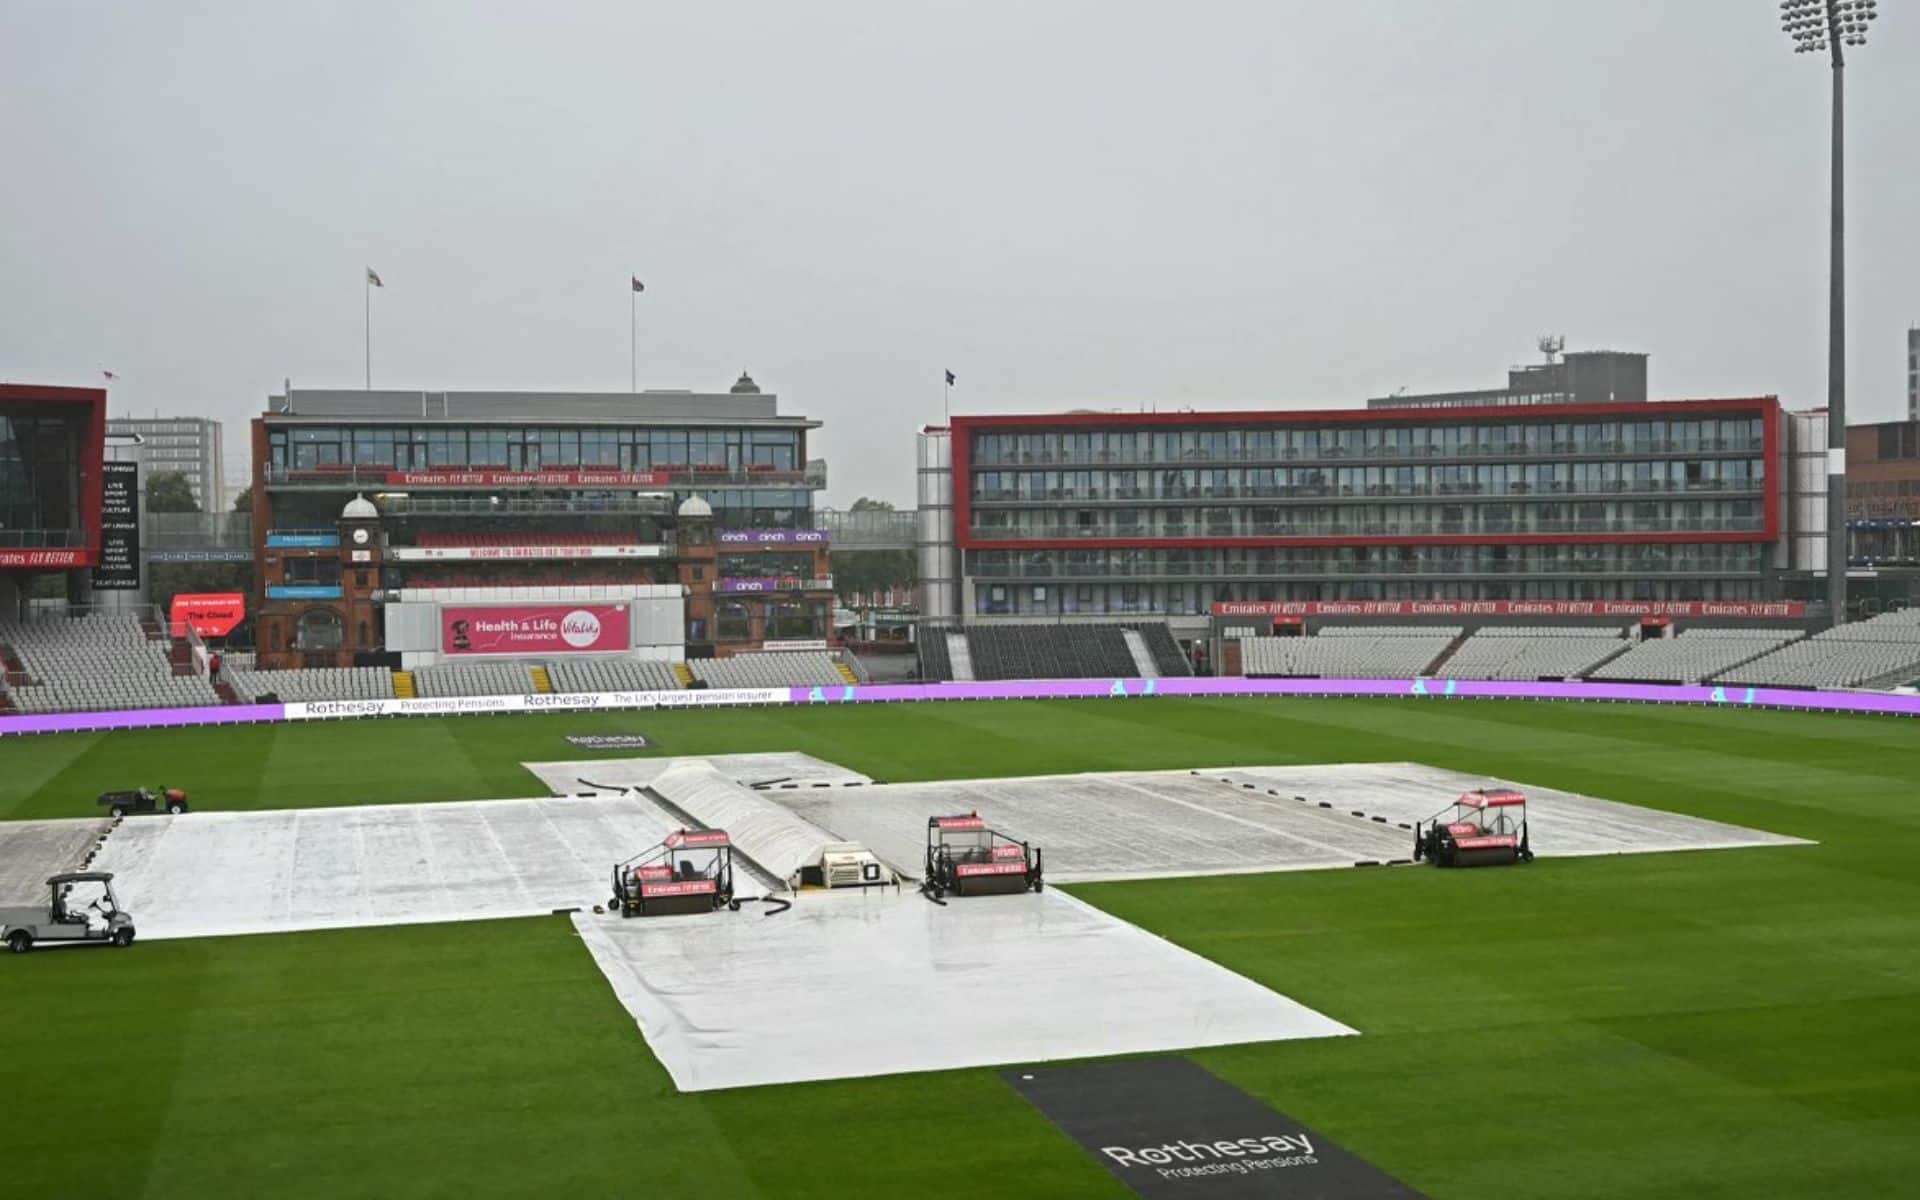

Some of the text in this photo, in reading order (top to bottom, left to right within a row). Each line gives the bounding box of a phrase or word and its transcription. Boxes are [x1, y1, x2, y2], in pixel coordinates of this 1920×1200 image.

[721, 532, 822, 541] cinch cinch cinch
[45, 552, 75, 565] BETTER
[736, 582, 762, 590] cinch
[1222, 603, 1265, 614] Emirates
[1316, 603, 1361, 614] Emirates
[1411, 603, 1457, 614] Emirates
[1508, 603, 1553, 614] Emirates
[1604, 603, 1649, 614] Emirates
[1702, 603, 1748, 614] Emirates
[475, 620, 557, 631] Health & Life
[562, 619, 599, 638] Vitality
[510, 632, 558, 641] Insurance
[524, 693, 599, 706] Rothesay
[615, 694, 632, 703] The
[658, 692, 693, 705] largest
[695, 691, 736, 705] pension
[737, 690, 772, 701] insurer
[306, 701, 385, 715] Rothesay
[400, 697, 505, 712] Protecting Pensions
[1101, 1133, 1315, 1167] Rothesay
[1156, 1154, 1319, 1178] Protecting Pensions
